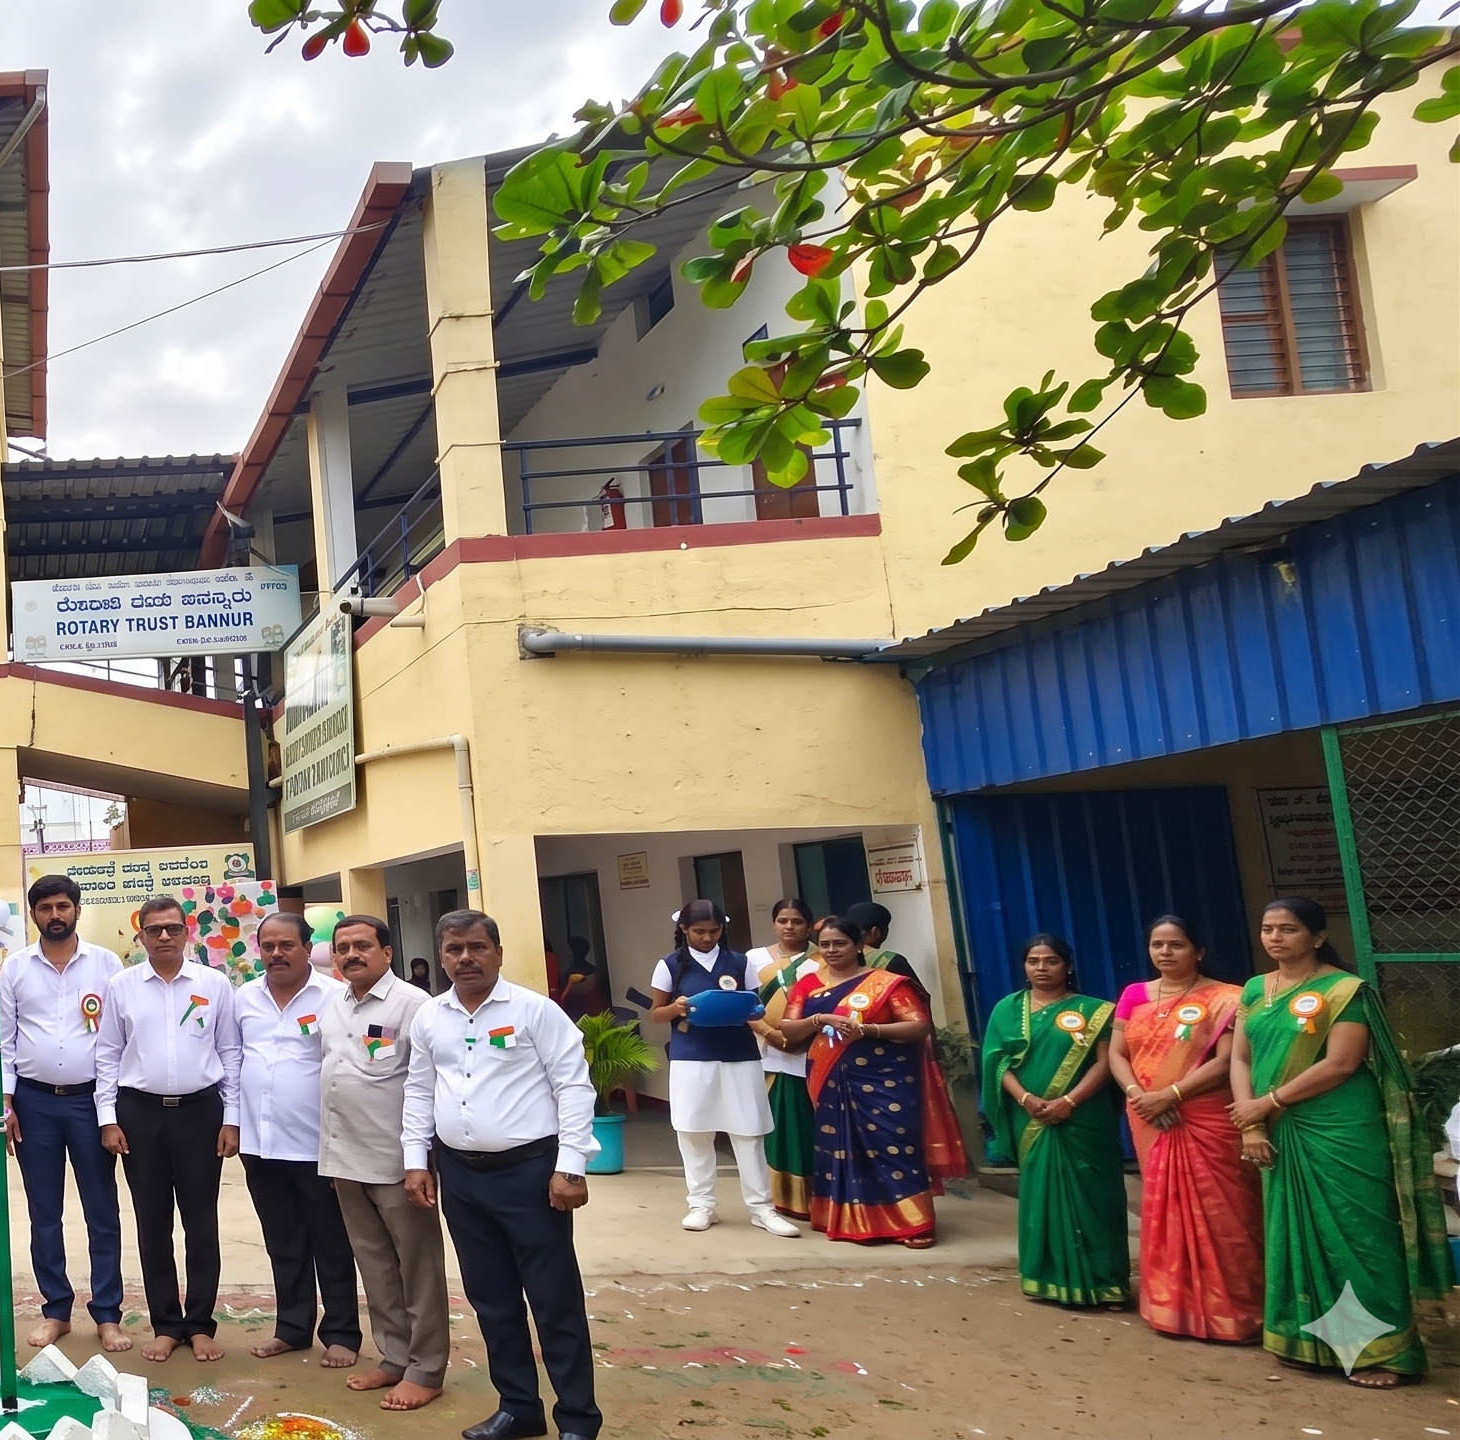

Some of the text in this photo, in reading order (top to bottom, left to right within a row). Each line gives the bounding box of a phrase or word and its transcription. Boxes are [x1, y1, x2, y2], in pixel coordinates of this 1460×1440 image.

[56, 611, 254, 636] ROTARY TRUST BANNUR
